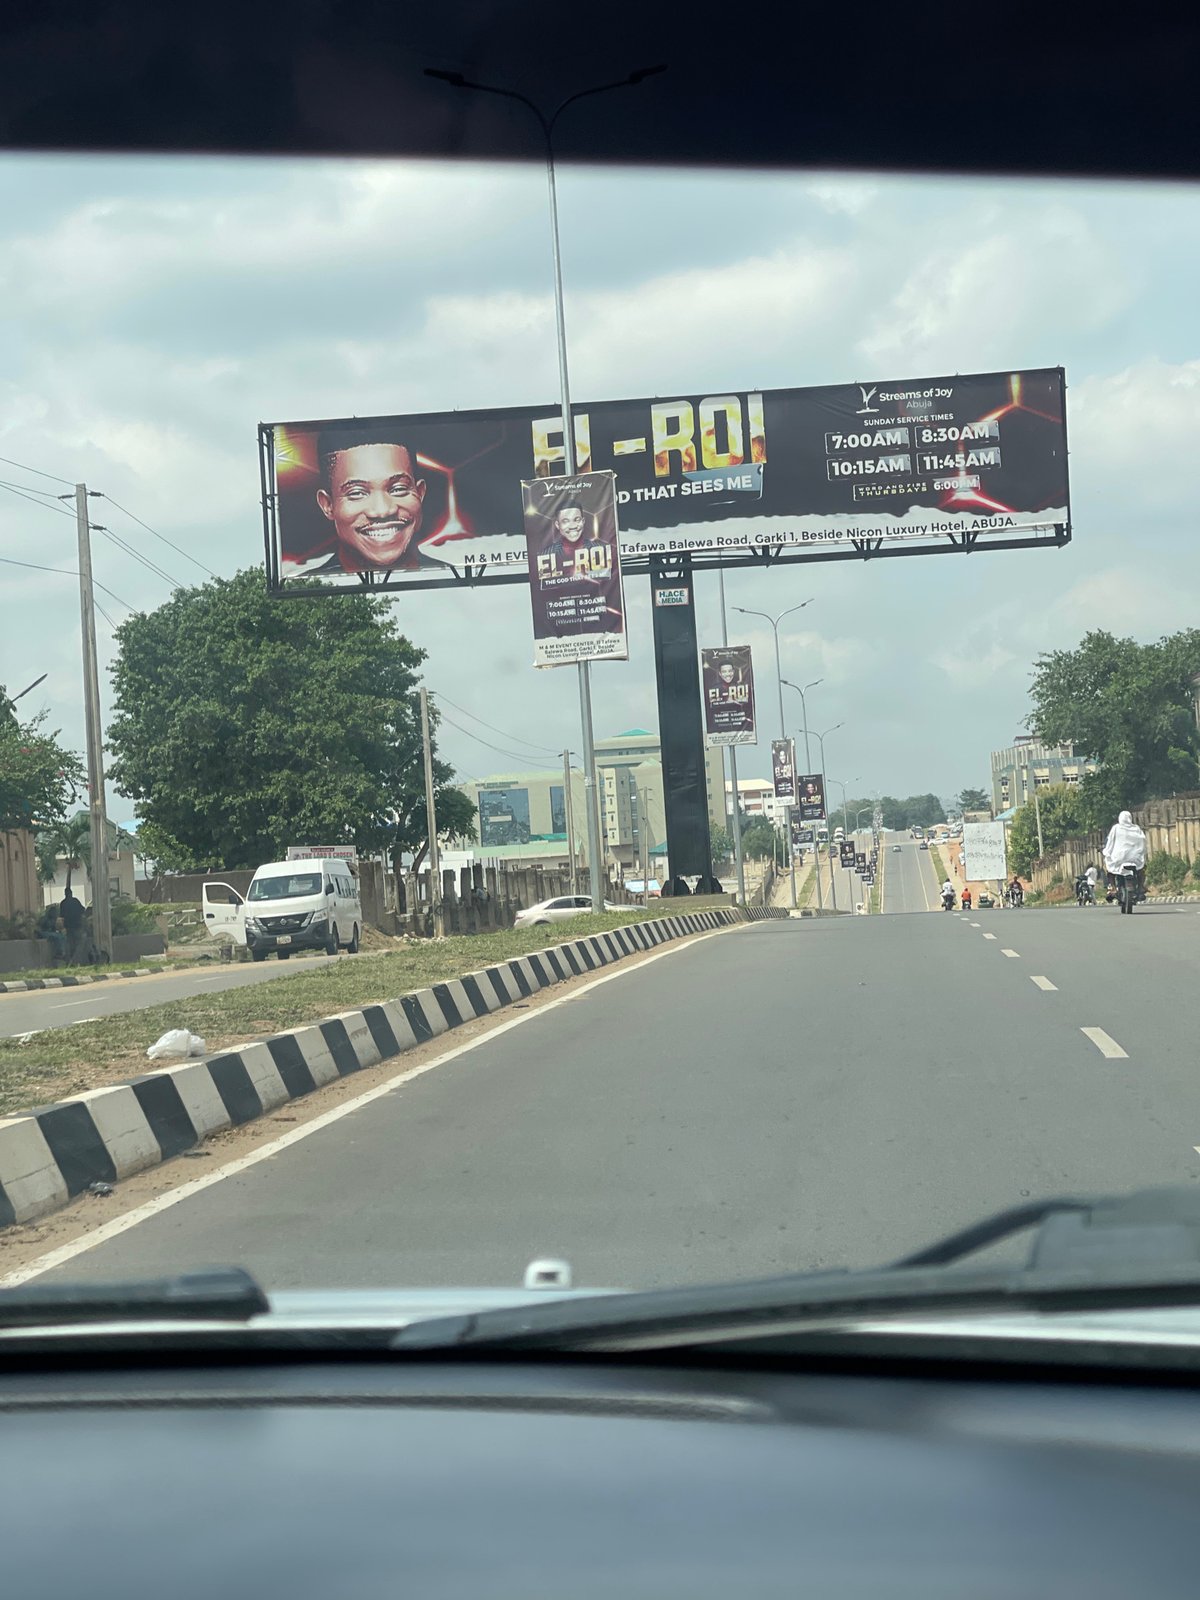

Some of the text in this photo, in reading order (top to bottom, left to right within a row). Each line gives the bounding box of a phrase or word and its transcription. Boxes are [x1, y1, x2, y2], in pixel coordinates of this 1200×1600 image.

[879, 388, 953, 402] Streams of Joy
[906, 399, 932, 410] Abuja
[863, 413, 954, 427] SUNDAY SERVICE TIMES
[831, 424, 990, 449] 7:00AM 8:30AM
[832, 450, 995, 476] 10:15AM 11:45AM
[633, 484, 678, 502] THAT
[681, 478, 724, 496] SEES
[727, 475, 752, 491] ME
[933, 479, 977, 491] 6:00PM
[464, 516, 1017, 564] M & M EVE Tafawa Balewa Road, Garki 1, Beside Nicon Luxury Hotel, ABUJA.
[537, 544, 613, 580] EL-ROI
